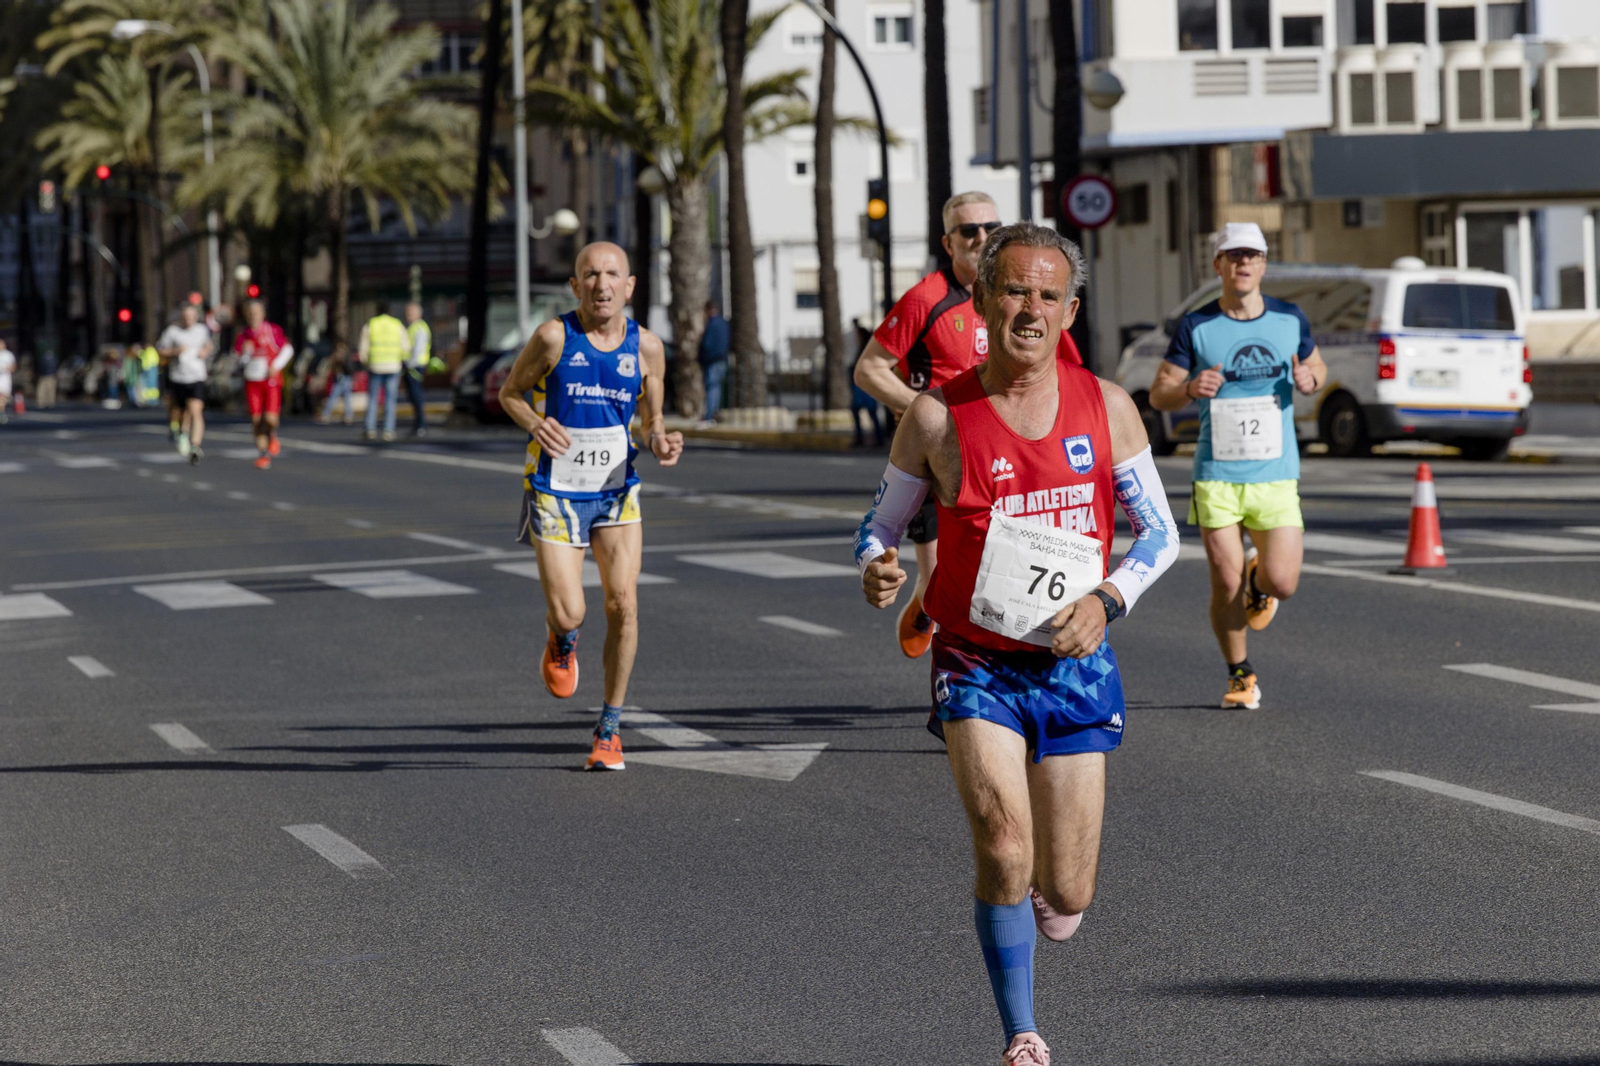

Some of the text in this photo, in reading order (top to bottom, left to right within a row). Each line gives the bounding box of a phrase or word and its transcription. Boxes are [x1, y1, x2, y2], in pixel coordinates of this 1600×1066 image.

[1076, 191, 1106, 212] 50
[1238, 419, 1260, 436] 12
[573, 450, 610, 466] 419
[993, 472, 1015, 482] mobel
[1018, 529, 1043, 541] XXXV
[1042, 534, 1068, 548] MEDIA
[1057, 549, 1068, 559] DE
[1026, 565, 1067, 601] 76
